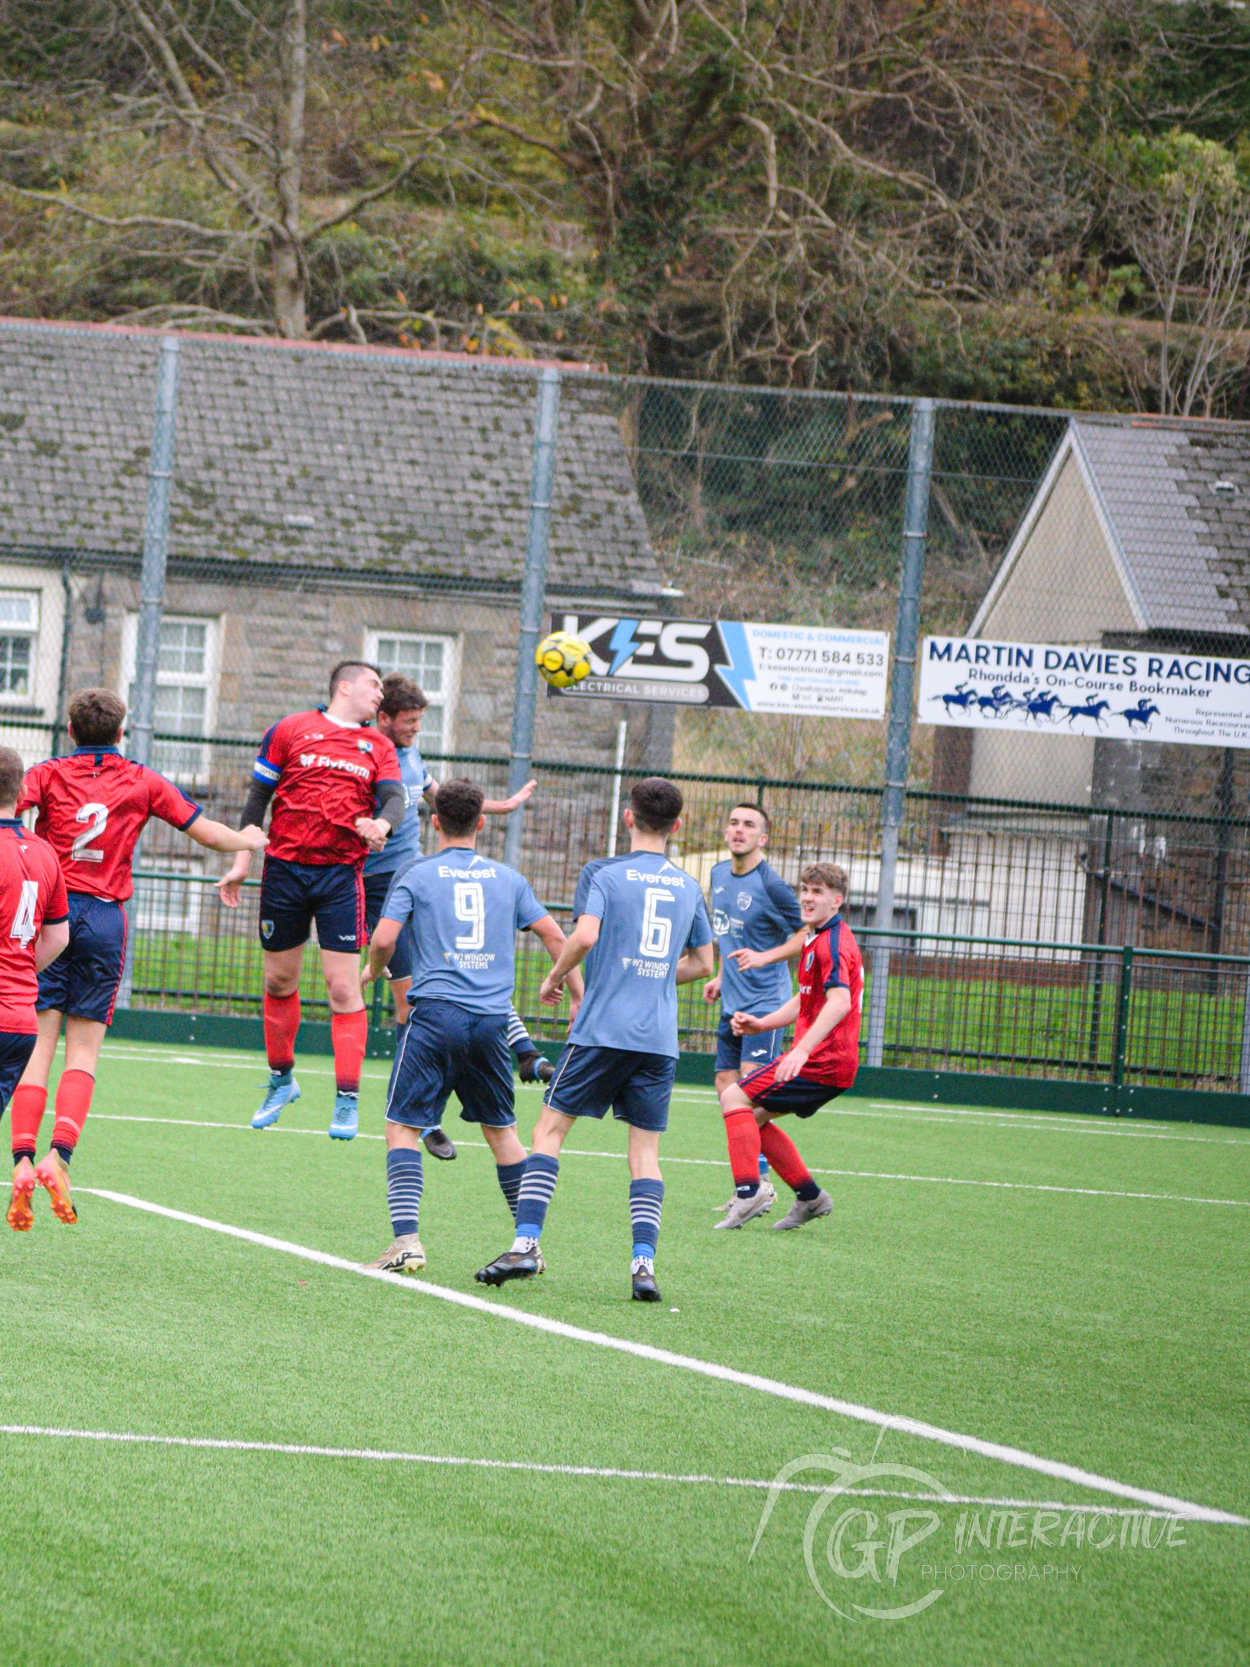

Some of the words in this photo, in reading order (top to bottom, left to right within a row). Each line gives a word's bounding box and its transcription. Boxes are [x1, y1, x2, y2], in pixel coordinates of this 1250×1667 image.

[753, 629, 805, 641] DOMESTIC
[807, 632, 815, 640] &
[817, 633, 886, 645] COMMERCIAL
[563, 615, 712, 682] KES
[759, 646, 772, 659] T:
[776, 647, 817, 662] 07771
[822, 650, 852, 664] 584
[856, 652, 884, 666] 533
[929, 641, 1034, 668] MARTIN
[1044, 650, 1138, 678] DAVIES
[1147, 658, 1250, 685] RACING
[643, 685, 705, 698] SERVICES
[968, 667, 1040, 685] Rhondda's
[1046, 674, 1124, 692] On-Course
[1129, 680, 1212, 698] Bookmaker
[1166, 716, 1203, 726] Numerous
[1196, 708, 1243, 719] Represented
[1174, 726, 1215, 738] Throughout
[1218, 729, 1231, 737] The
[317, 756, 370, 779] FlyForm
[71, 803, 109, 863] 2
[438, 866, 497, 879] Everest
[626, 869, 685, 888] Everest
[10, 880, 39, 949] 4
[454, 882, 485, 949] 9
[639, 887, 676, 959] 6
[459, 961, 489, 969] SYSTEMS
[465, 953, 496, 962] WINDOW
